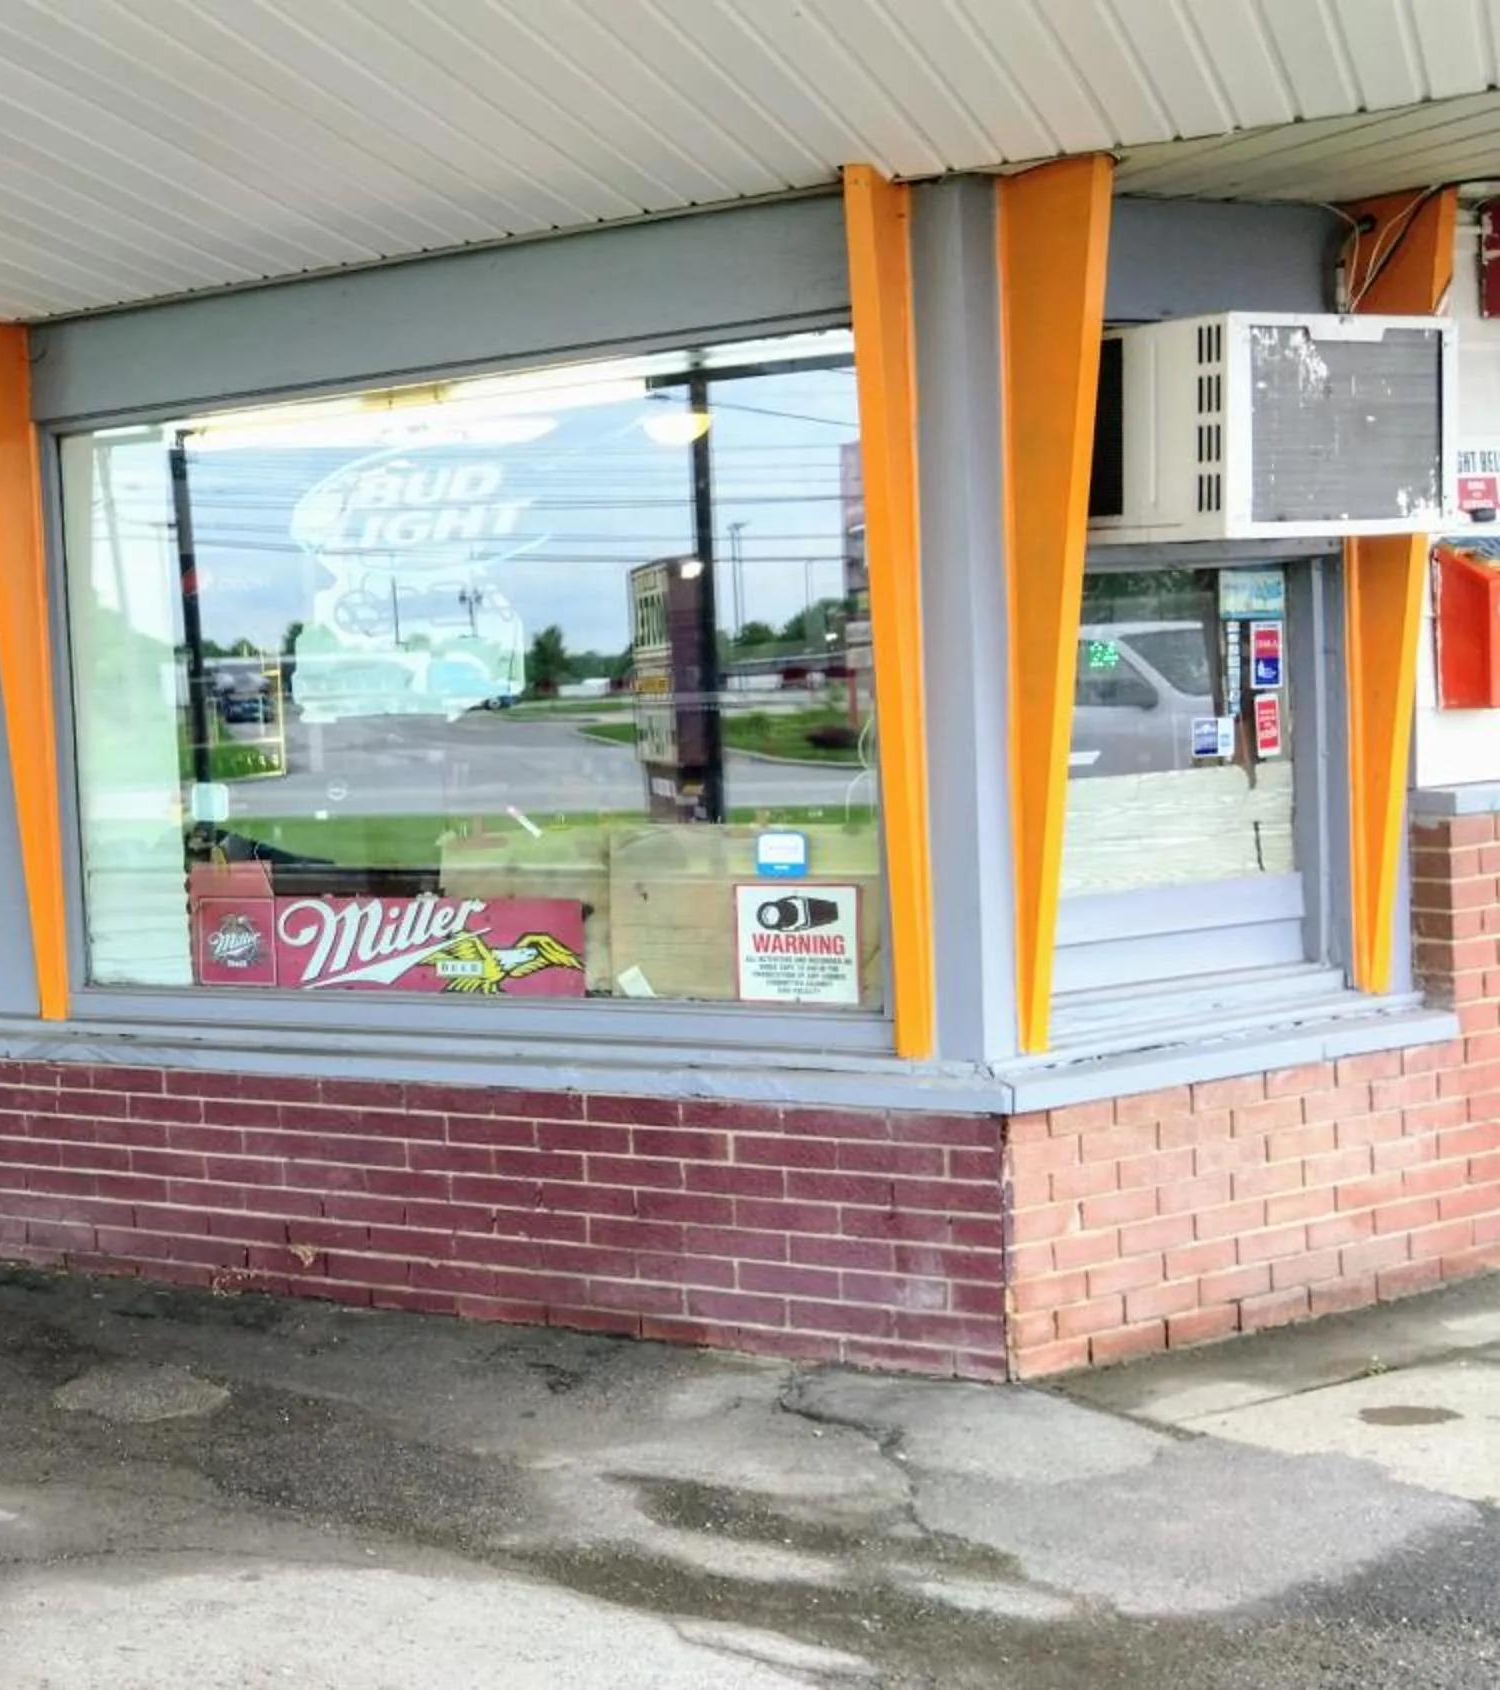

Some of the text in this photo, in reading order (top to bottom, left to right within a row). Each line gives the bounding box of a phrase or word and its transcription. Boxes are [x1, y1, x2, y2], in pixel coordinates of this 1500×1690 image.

[355, 463, 503, 505] BUD
[278, 893, 488, 981] Miller
[751, 933, 846, 955] WARNING
